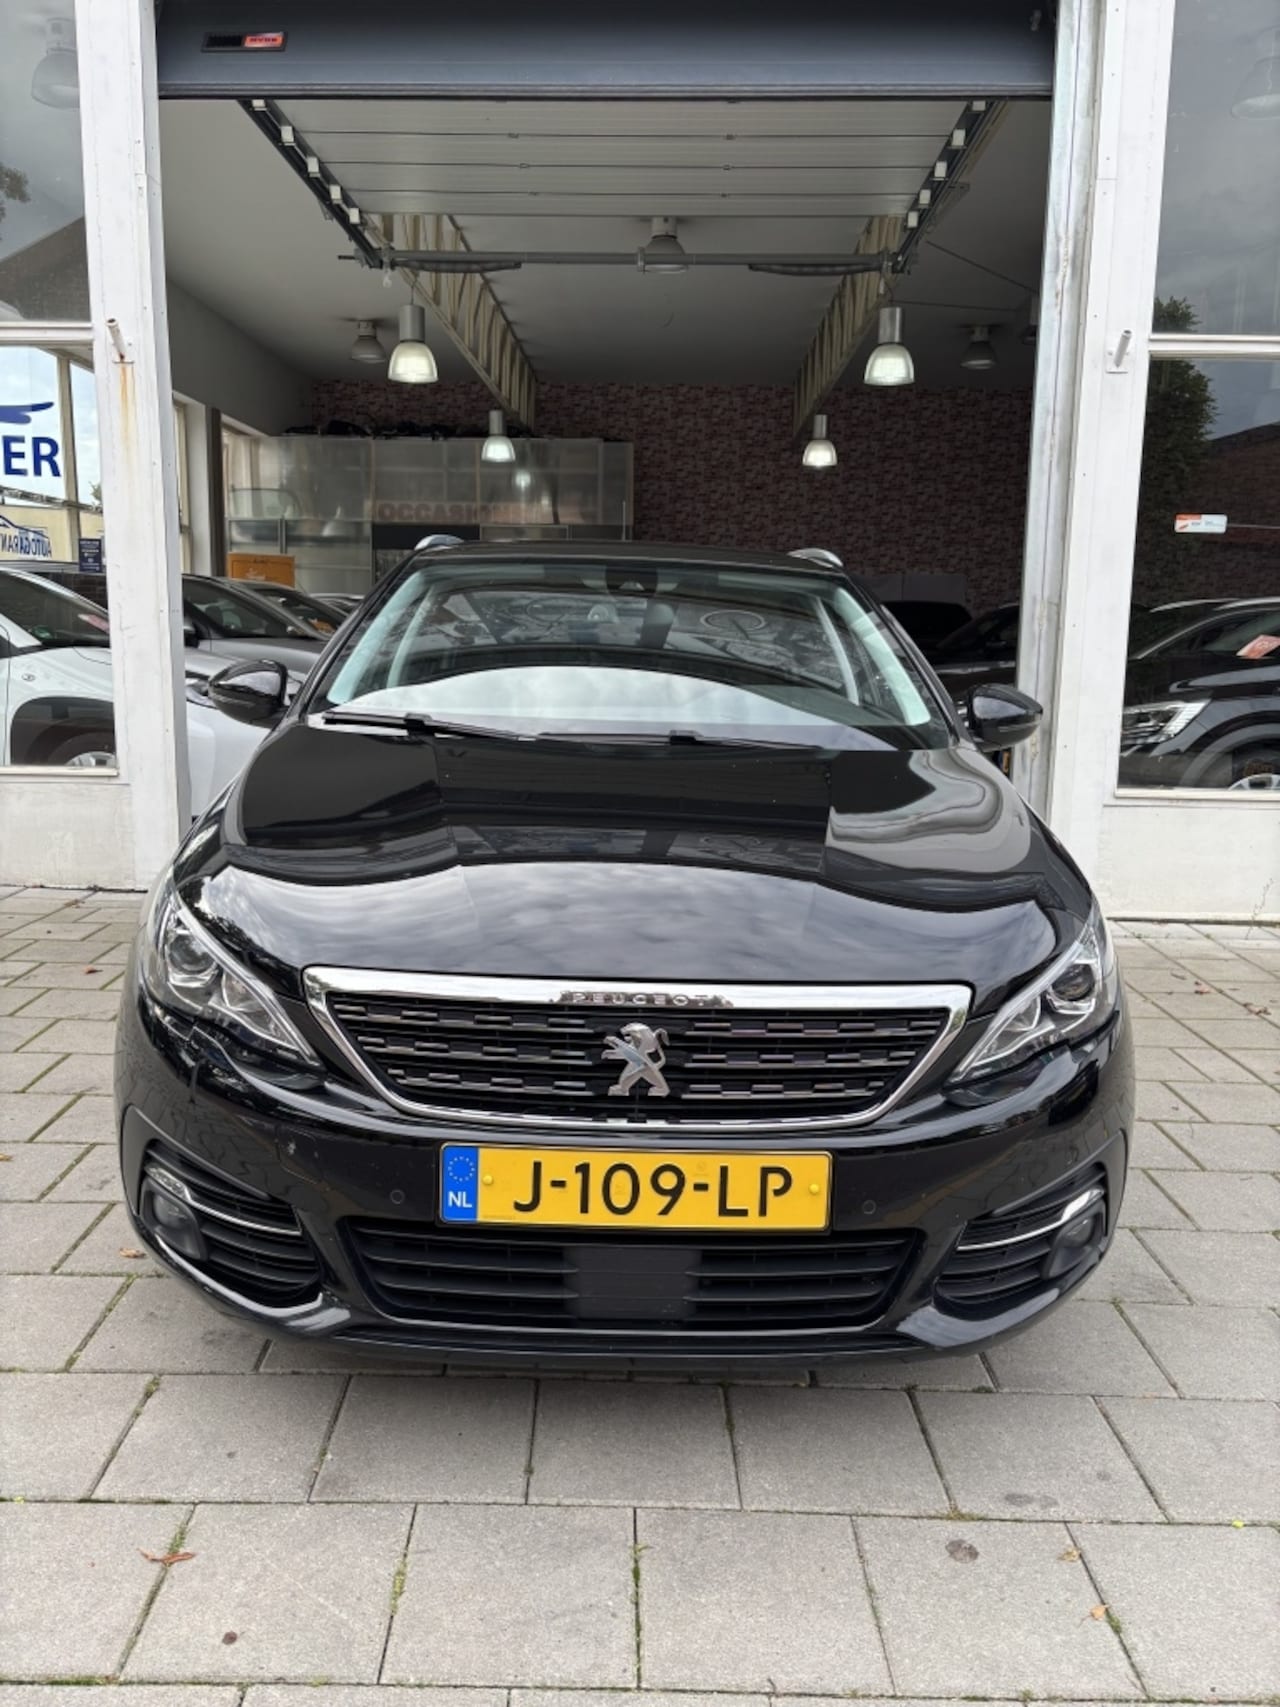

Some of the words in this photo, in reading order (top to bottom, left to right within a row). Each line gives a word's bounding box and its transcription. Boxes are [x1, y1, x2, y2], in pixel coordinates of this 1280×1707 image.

[572, 991, 709, 1007] PEUGEOT
[513, 1160, 793, 1217] J-109-LP
[448, 1191, 473, 1209] NL
